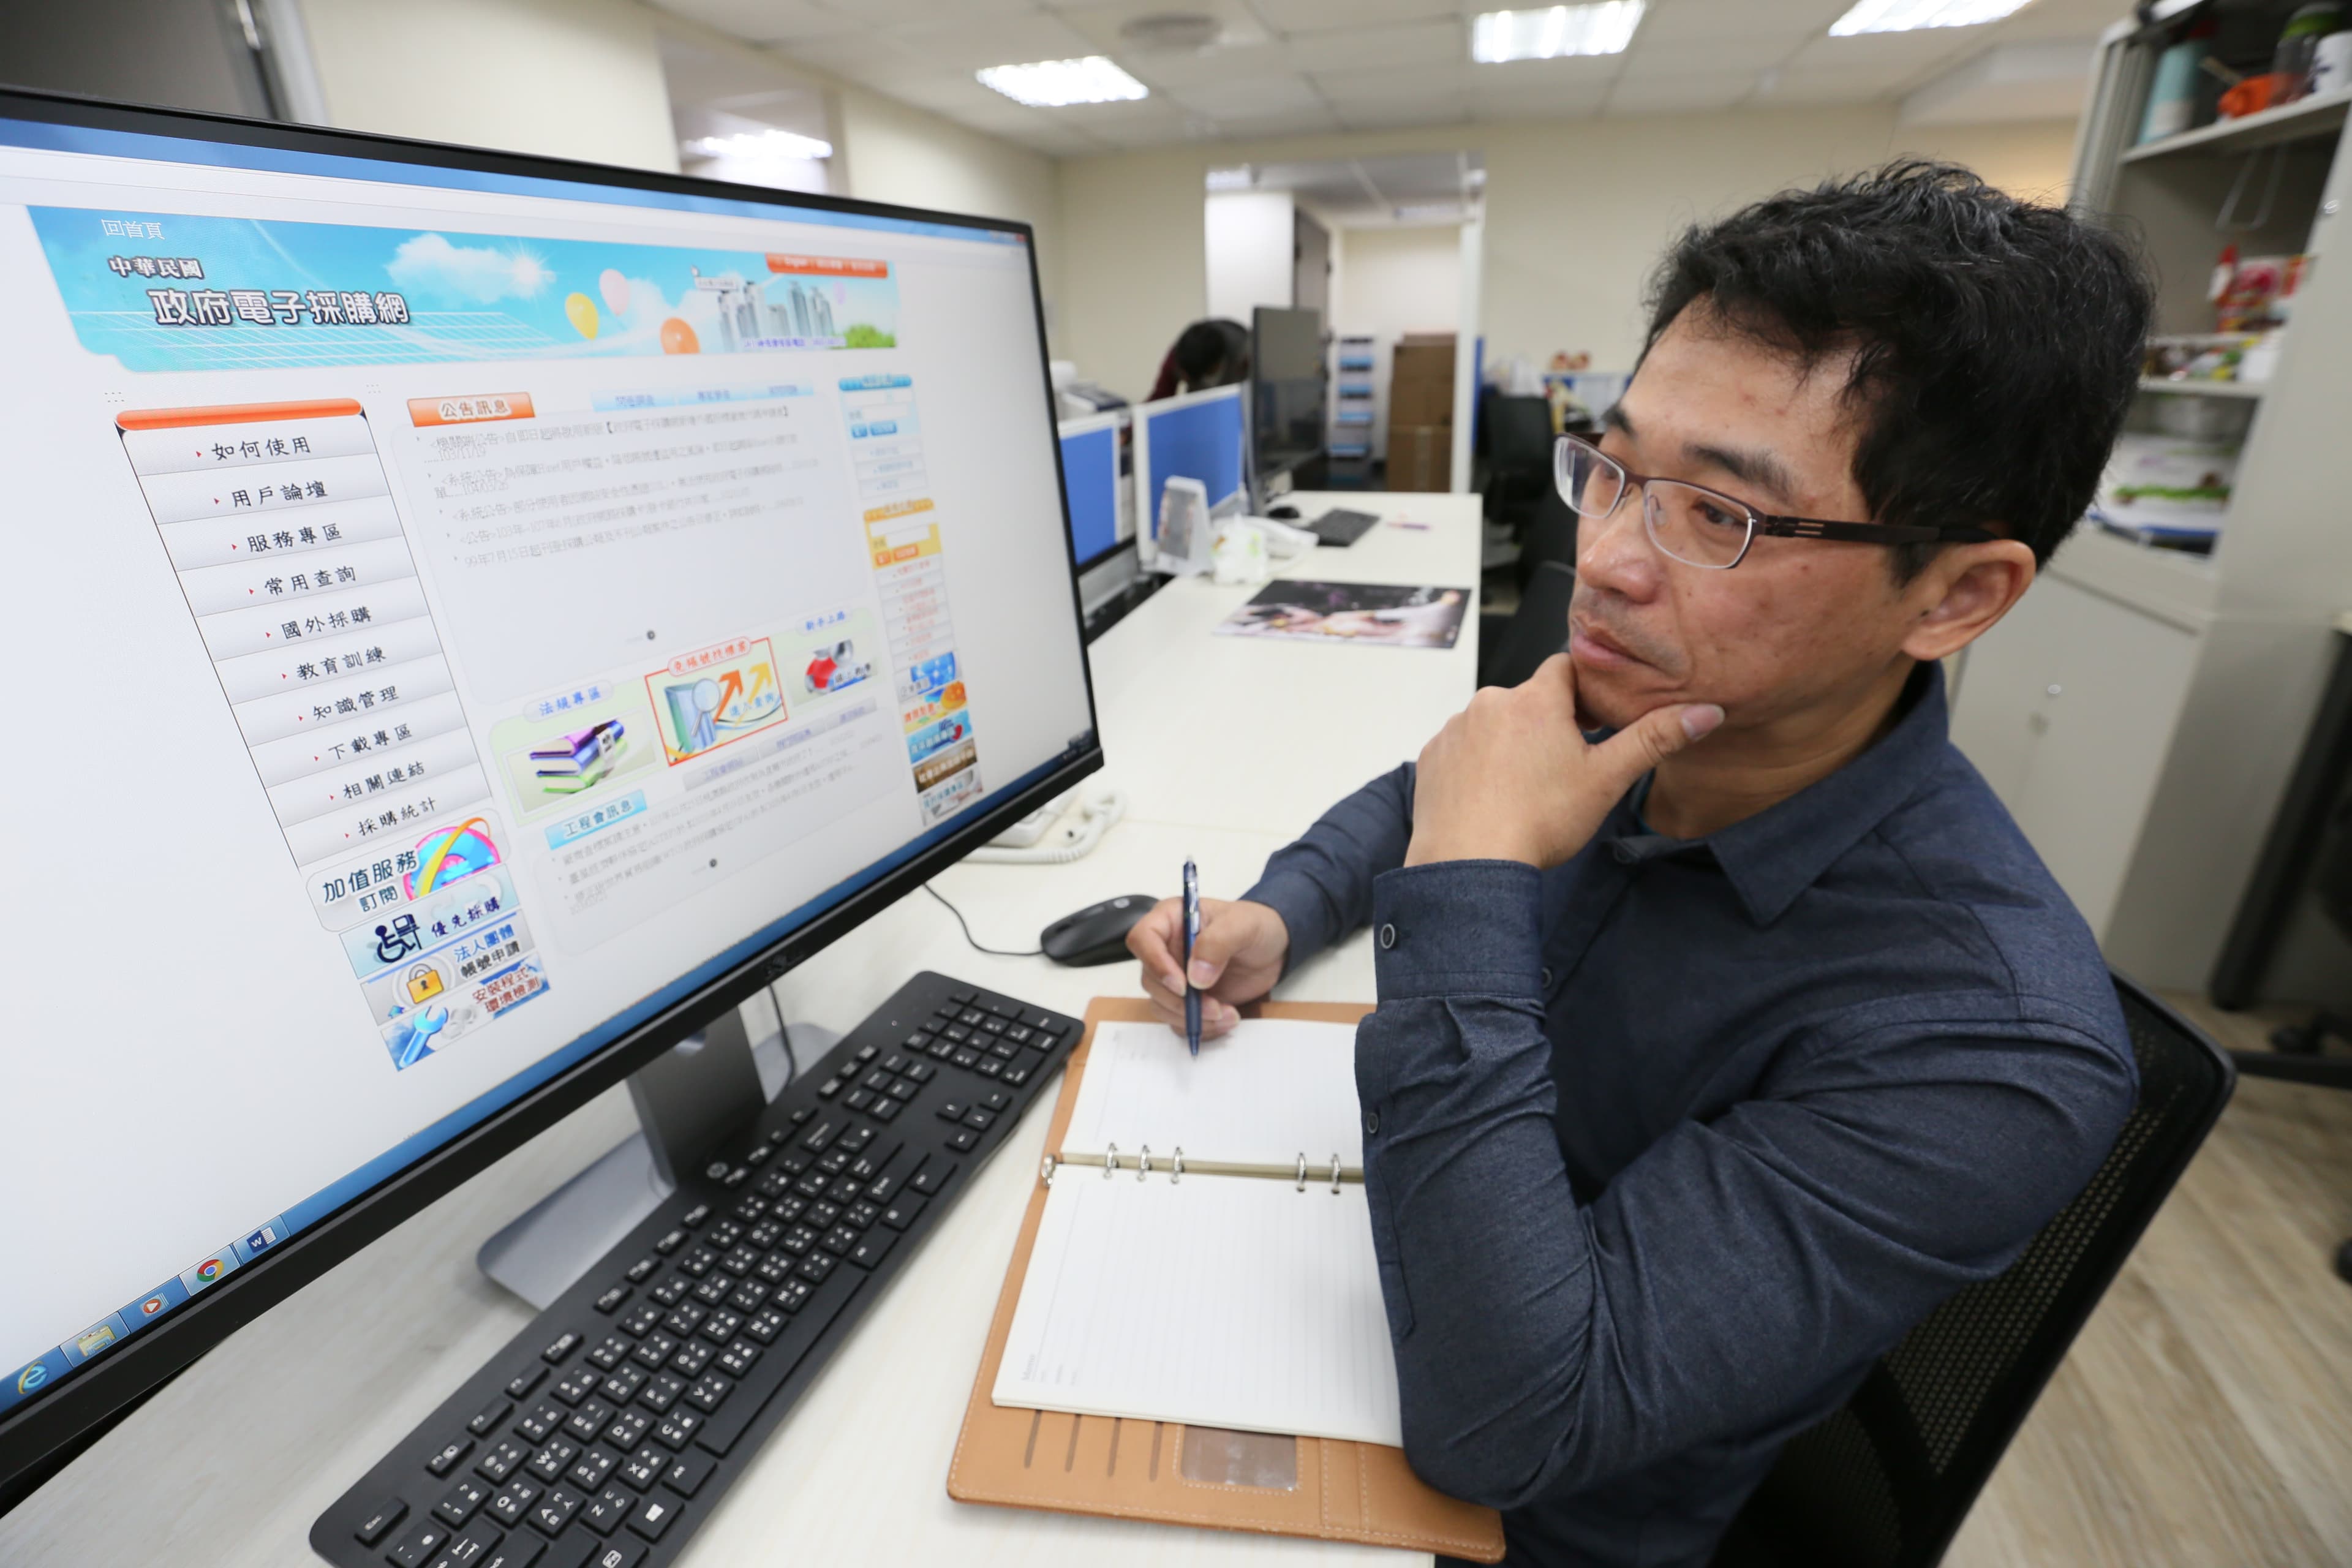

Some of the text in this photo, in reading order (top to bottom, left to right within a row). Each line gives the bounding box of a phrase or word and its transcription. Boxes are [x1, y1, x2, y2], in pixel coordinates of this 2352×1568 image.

[101, 219, 164, 240] 回首頁
[109, 256, 204, 279] 中華民國
[147, 288, 410, 326] 政府電子採購網
[441, 400, 510, 418] 公告訊息
[211, 437, 312, 462] 如何使用
[231, 480, 328, 508] 用戶論壇
[247, 522, 342, 553] 服務專區
[264, 565, 357, 596] 常用查詢
[281, 607, 372, 639] 國外採購
[296, 646, 387, 680] 教育訓練
[312, 685, 399, 720] 知識管理
[538, 686, 601, 716] 法規專區
[329, 723, 412, 761] 下載專區
[342, 761, 426, 799] 相關連結
[358, 797, 437, 836] 採購統計
[564, 800, 633, 837] 工程會訊息
[322, 850, 420, 903] 加值服務
[360, 885, 399, 913] 訂閱
[431, 897, 501, 937] 優先採購
